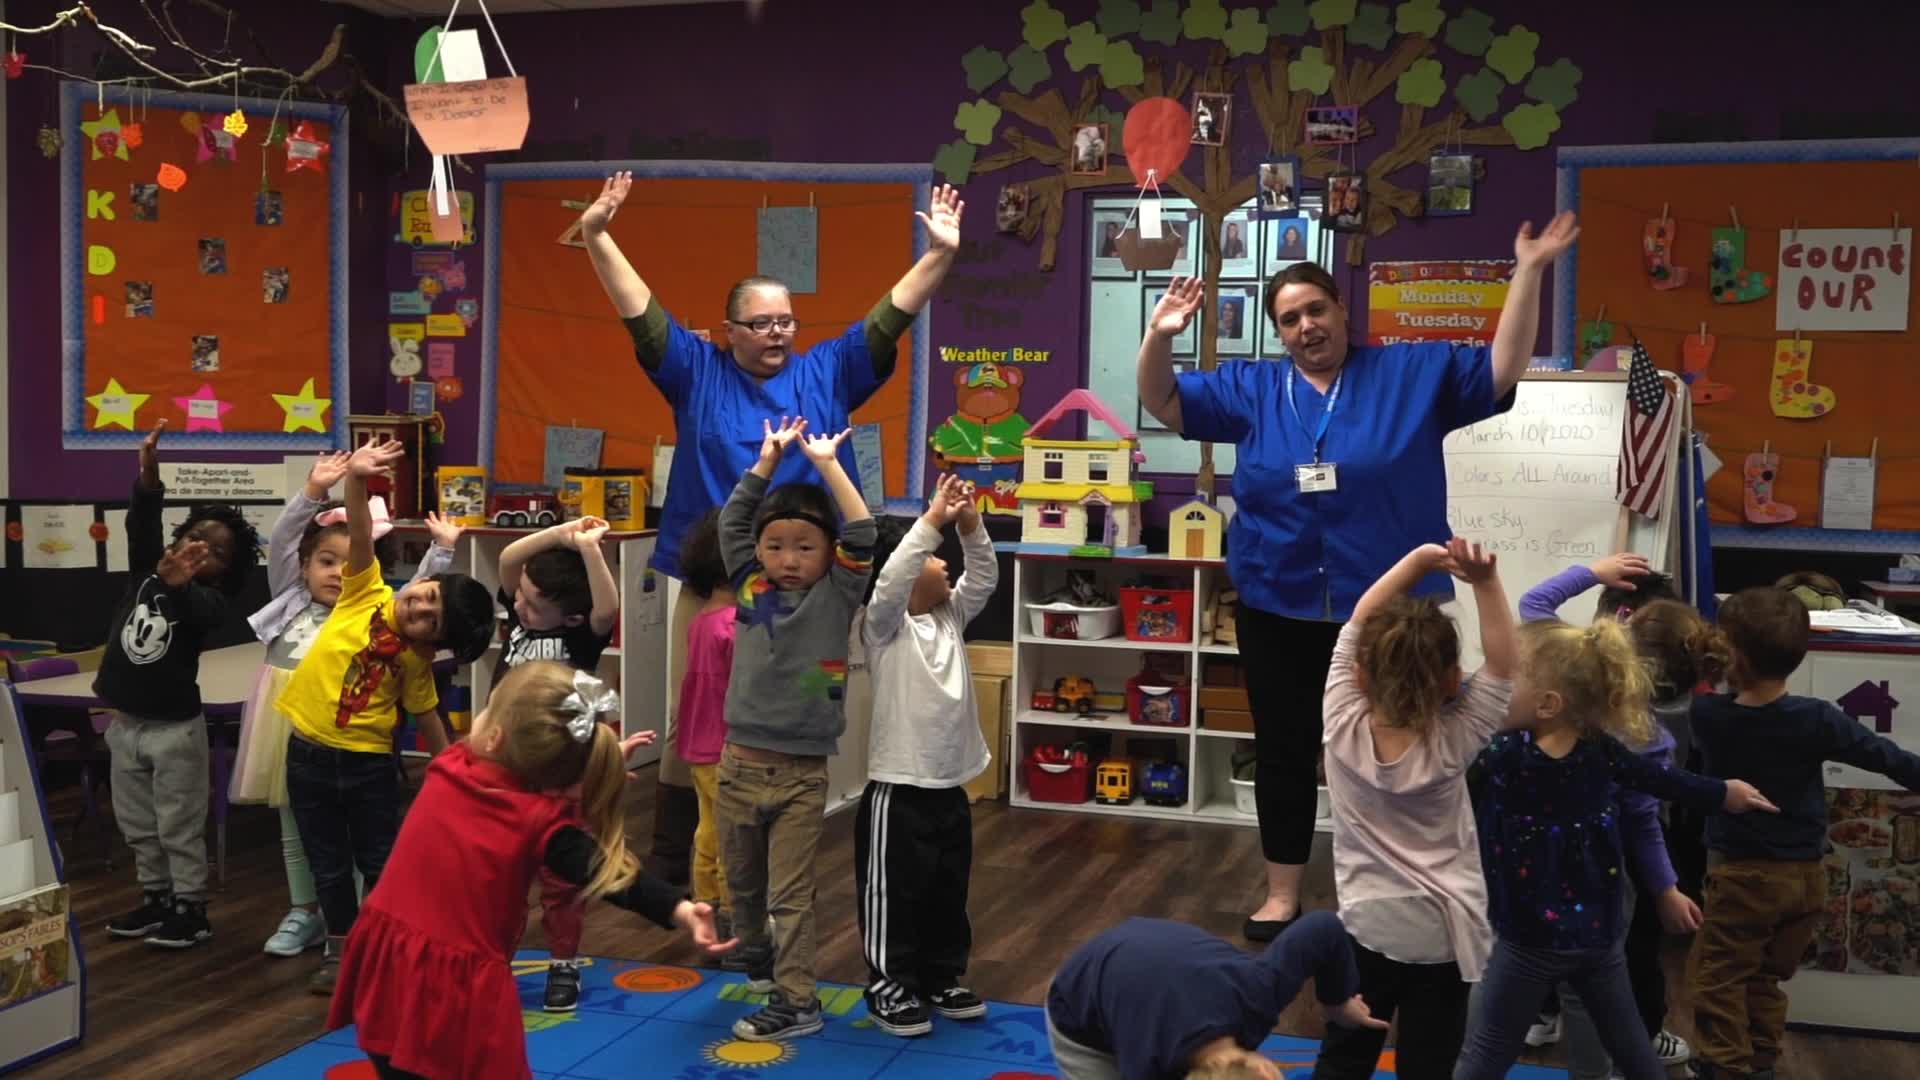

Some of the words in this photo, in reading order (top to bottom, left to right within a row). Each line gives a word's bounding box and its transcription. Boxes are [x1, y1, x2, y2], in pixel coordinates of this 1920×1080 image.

[1400, 288, 1484, 306] Monday
[1797, 275, 1877, 313] OUR
[1396, 311, 1487, 330] Tuesday
[941, 347, 1008, 362] Weather
[1012, 347, 1050, 362] Bear
[1455, 424, 1513, 446] March
[233, 477, 255, 485] Area
[1512, 461, 1549, 483] ALL
[1552, 463, 1612, 485] Around
[232, 488, 274, 496] desarmar
[1547, 529, 1597, 556] Green
